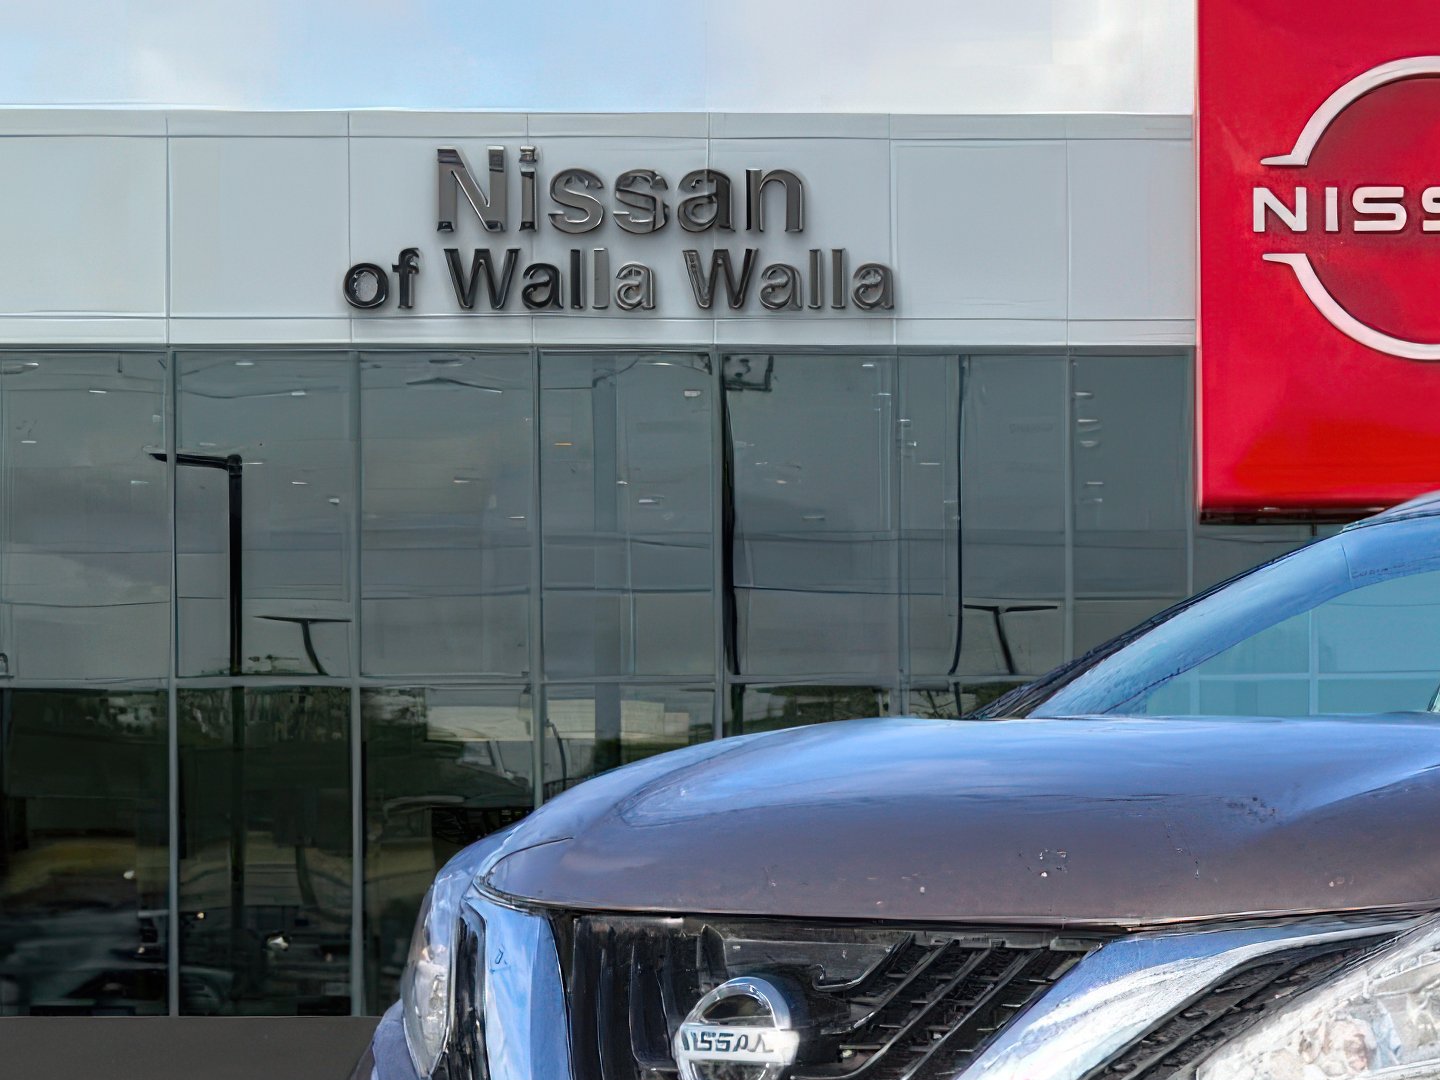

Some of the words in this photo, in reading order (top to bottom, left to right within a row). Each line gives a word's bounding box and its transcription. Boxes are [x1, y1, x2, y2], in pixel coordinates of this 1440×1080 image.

[435, 145, 807, 234] Nissan
[342, 246, 421, 310] of
[443, 246, 656, 311] Walla
[681, 246, 895, 311] Walla
